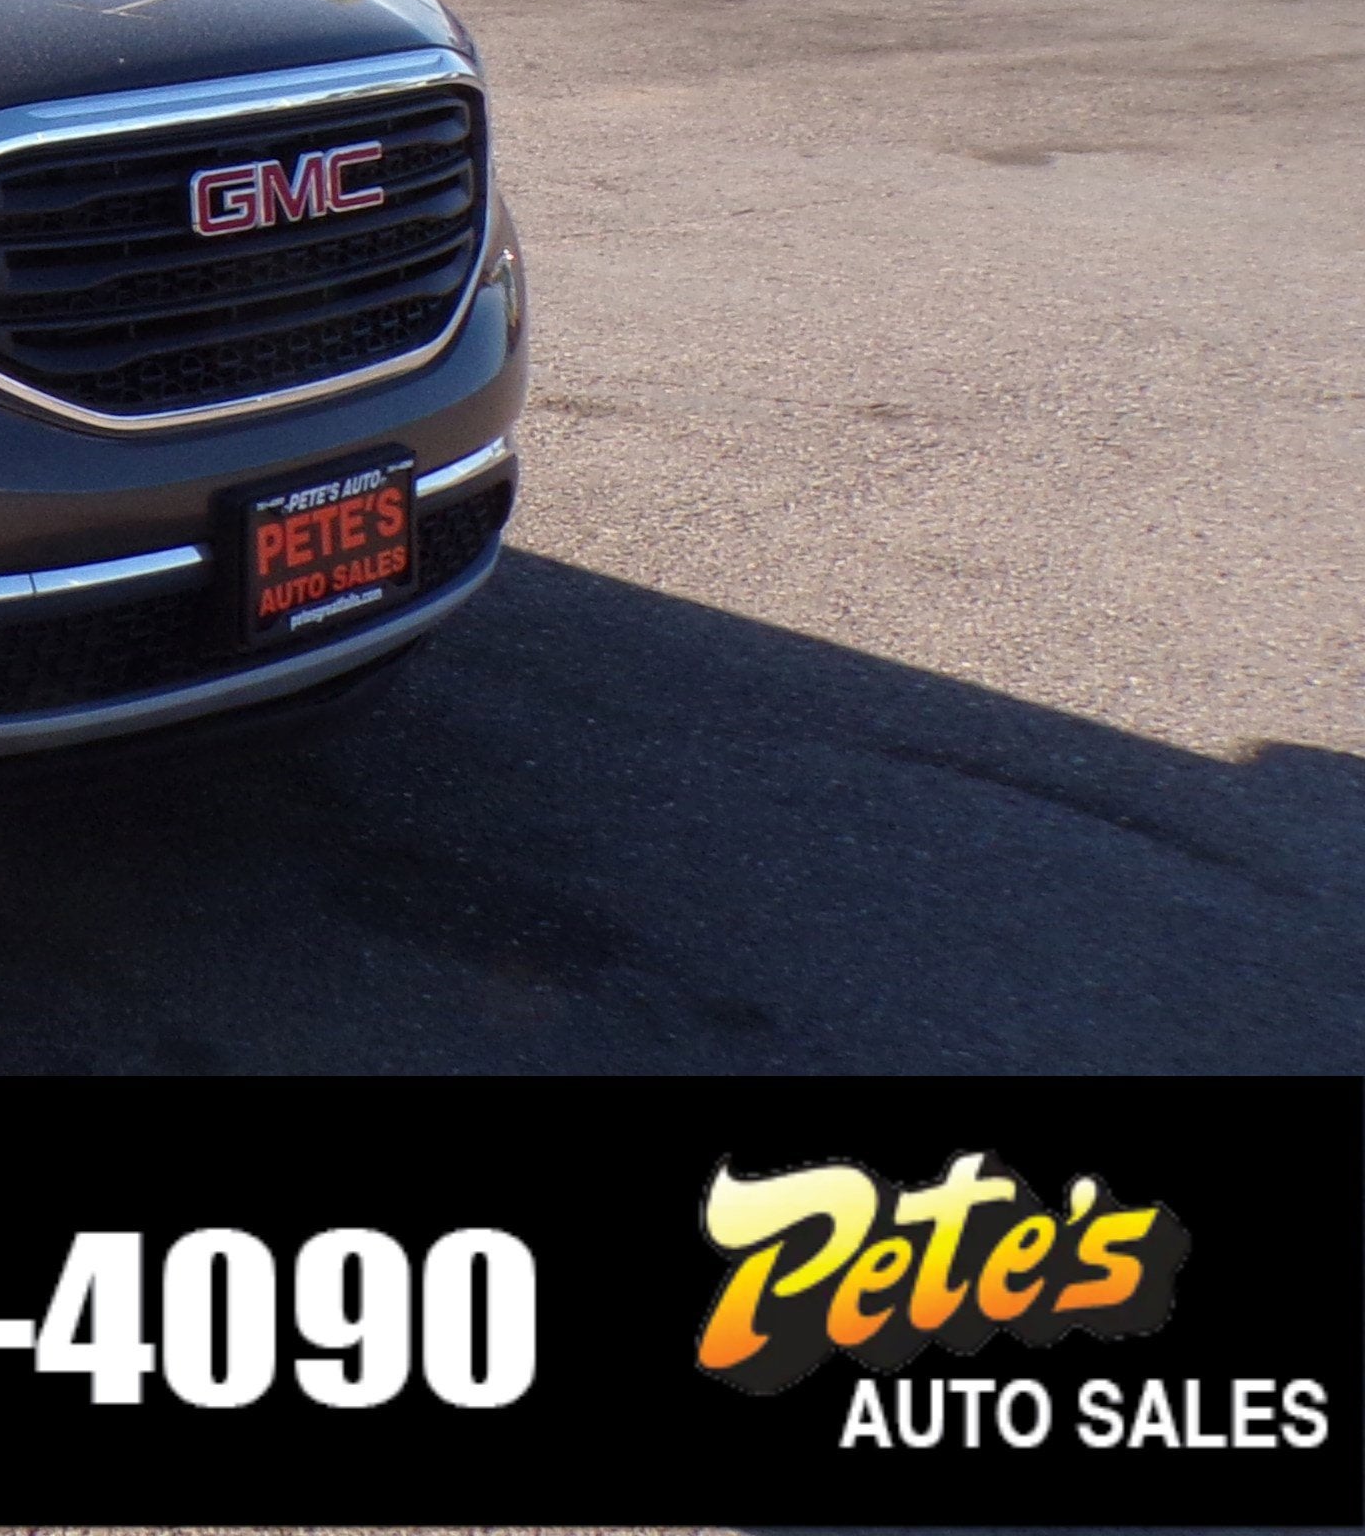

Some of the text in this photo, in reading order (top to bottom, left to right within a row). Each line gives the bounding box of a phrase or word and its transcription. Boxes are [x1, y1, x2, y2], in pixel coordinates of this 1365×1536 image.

[190, 140, 385, 237] GMC
[256, 486, 405, 577] PETE'S
[258, 571, 327, 619] AUTO
[332, 545, 408, 592] SALES
